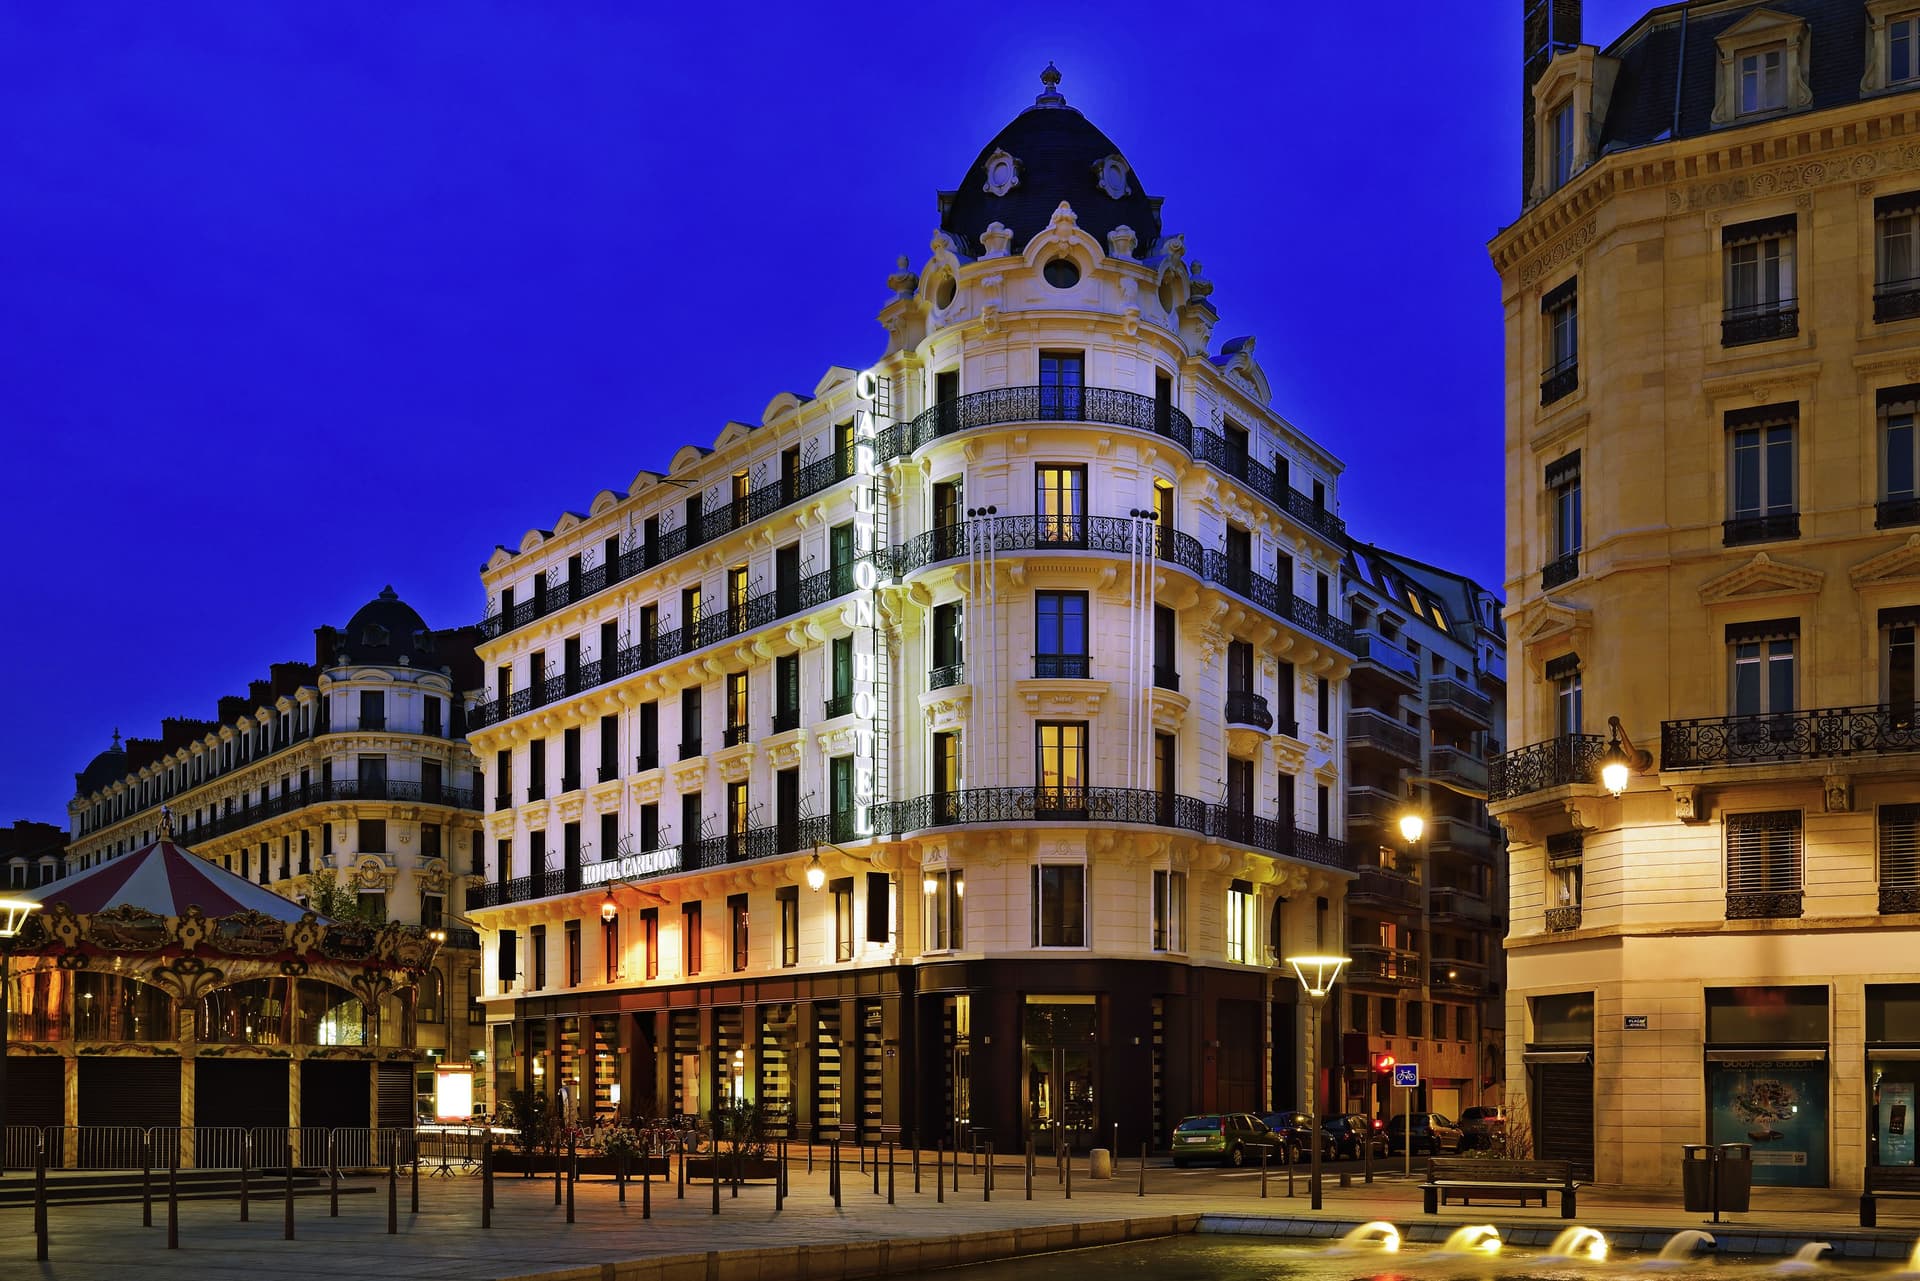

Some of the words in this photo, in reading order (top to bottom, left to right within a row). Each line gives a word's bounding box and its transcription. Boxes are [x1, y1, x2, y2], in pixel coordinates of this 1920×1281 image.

[854, 371, 876, 628] CARLTON
[853, 653, 875, 834] HOTEL
[1017, 796, 1114, 812] CARTON
[582, 861, 620, 884] HOTEL
[622, 848, 677, 876] CARLTON
